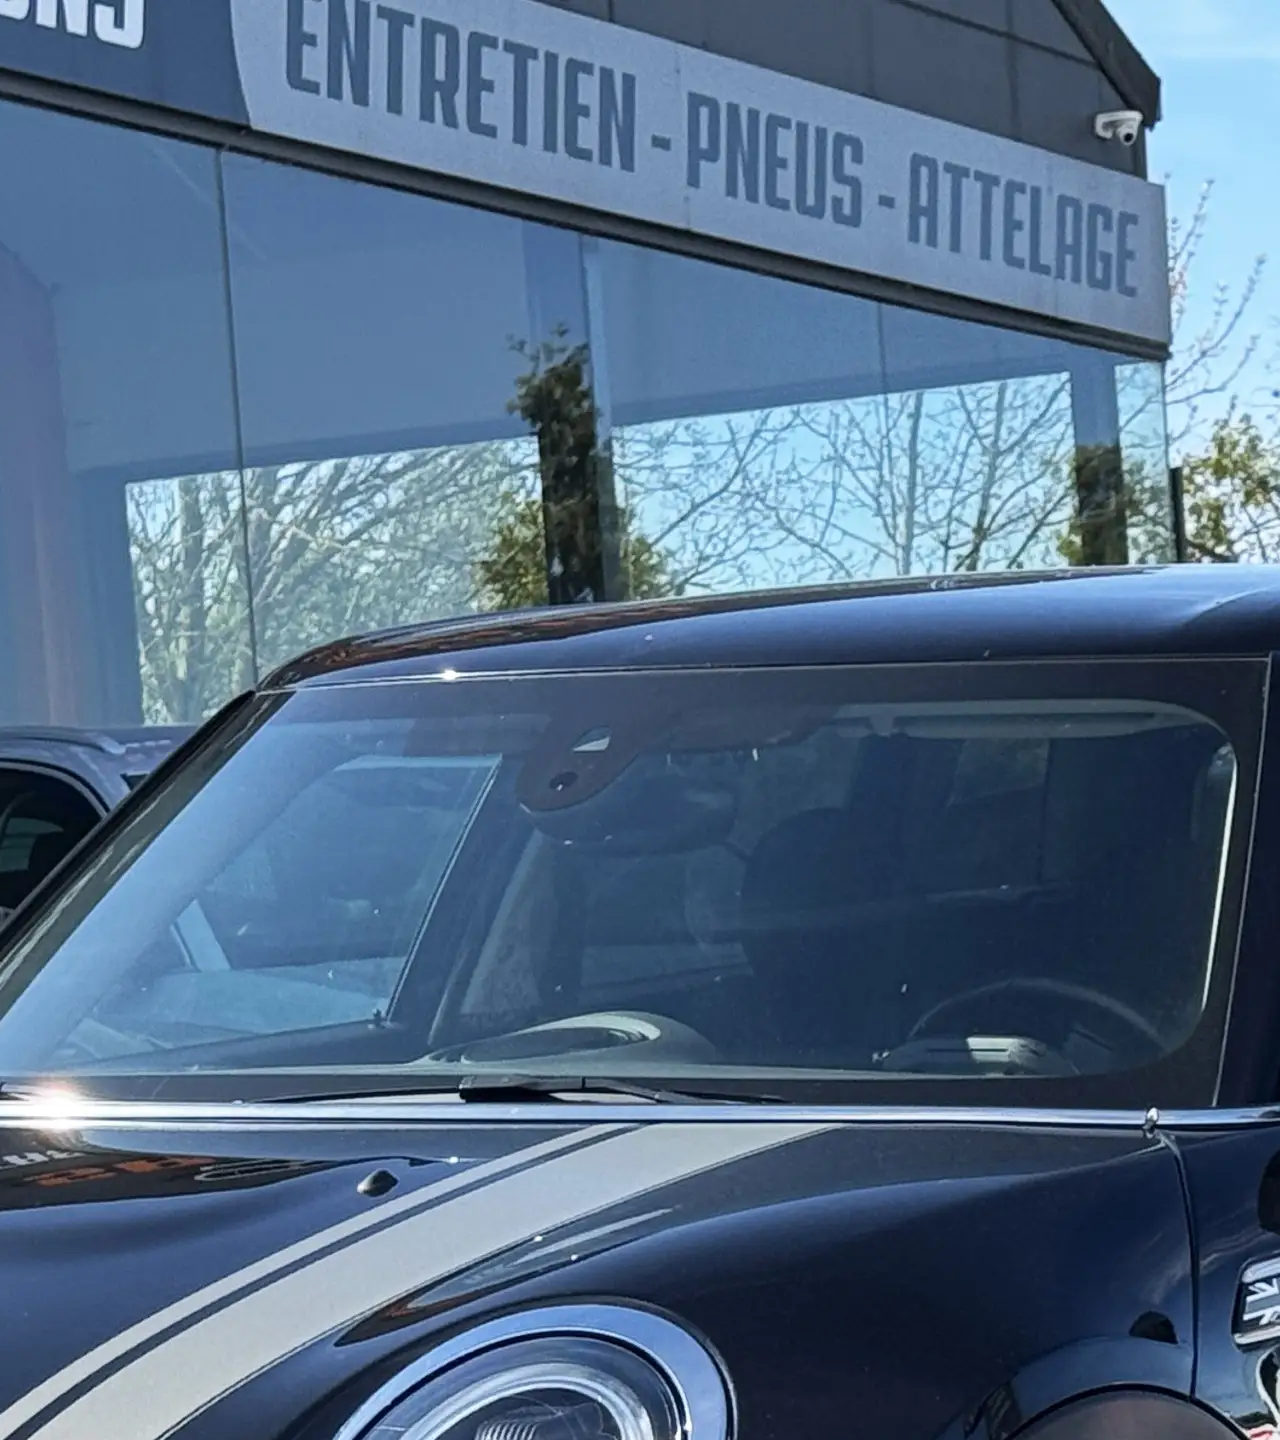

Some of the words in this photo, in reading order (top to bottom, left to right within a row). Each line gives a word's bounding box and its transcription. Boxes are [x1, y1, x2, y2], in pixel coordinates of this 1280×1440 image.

[285, 0, 636, 173] ENTRETIEN
[686, 91, 864, 228] PNEUS
[907, 152, 1140, 298] ATTELAGE
